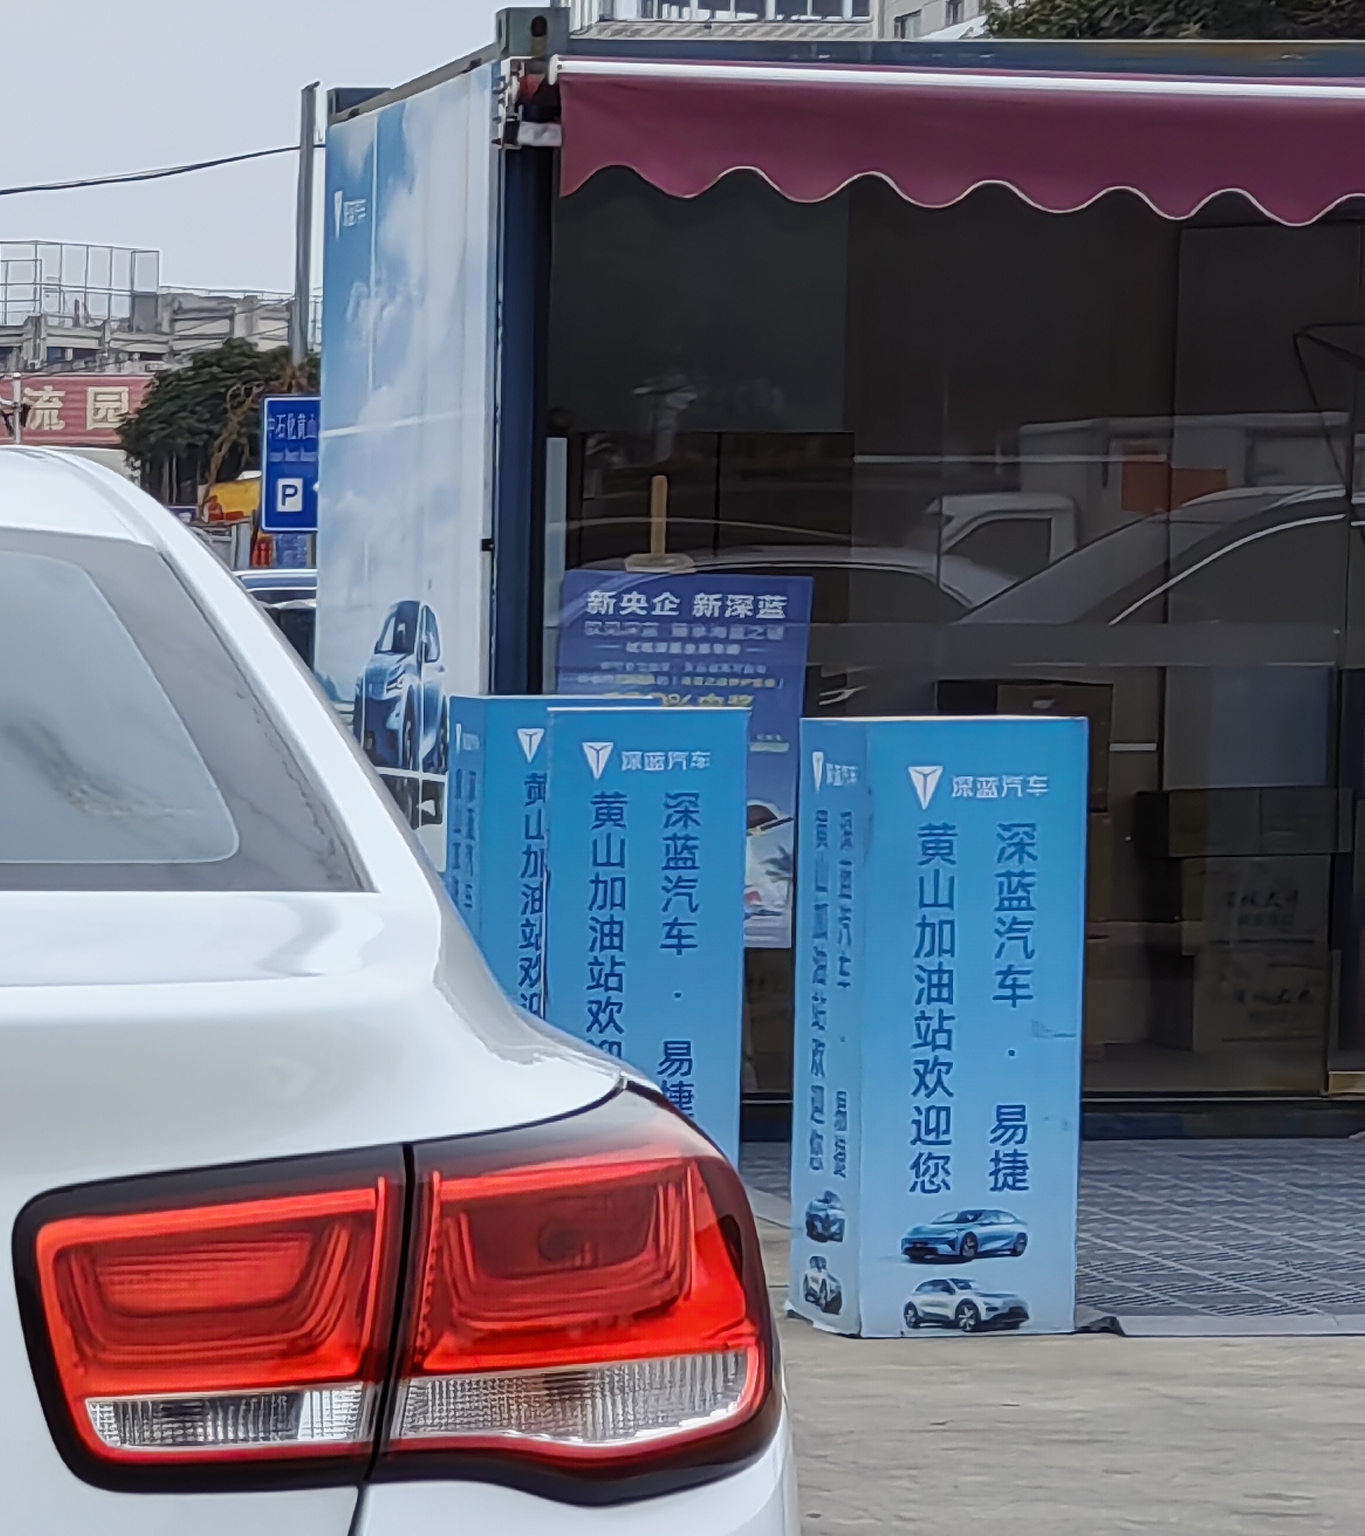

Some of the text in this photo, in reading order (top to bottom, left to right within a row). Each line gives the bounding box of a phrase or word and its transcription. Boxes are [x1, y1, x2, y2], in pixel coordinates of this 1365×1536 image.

[281, 484, 298, 506] P
[585, 590, 788, 619] 新央企 新深蓝
[951, 774, 1049, 799] 深蓝汽车
[908, 822, 958, 1195] 黄山加油站欢迎您
